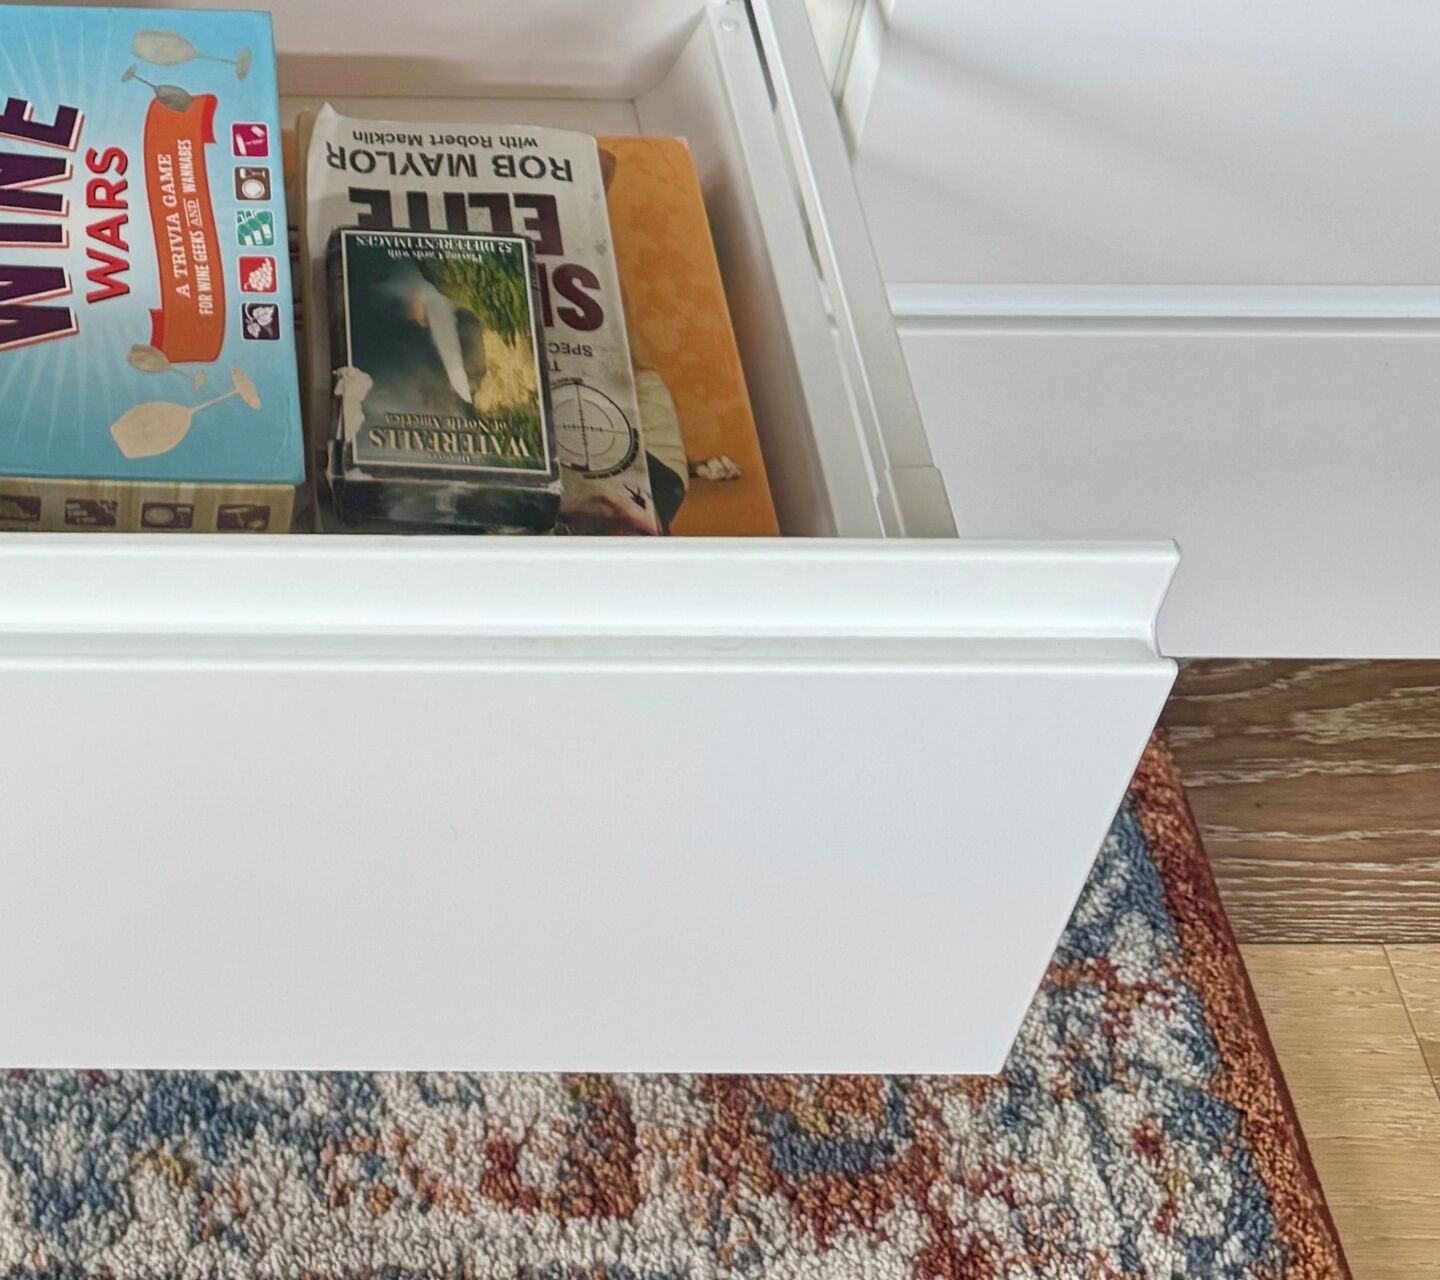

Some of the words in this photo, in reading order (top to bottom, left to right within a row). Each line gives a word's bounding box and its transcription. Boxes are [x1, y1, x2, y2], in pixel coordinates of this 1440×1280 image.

[352, 130, 423, 147] Macklin
[430, 132, 493, 148] Robert
[499, 137, 538, 149] with
[177, 139, 196, 192] WANNABES
[326, 142, 477, 179] MAYLOR
[492, 154, 573, 182] ROB
[157, 154, 177, 207] GAME
[187, 200, 201, 225] AND
[85, 146, 130, 303] WARS
[166, 212, 188, 278] TRIVIA
[189, 230, 208, 261] GEEKS
[355, 235, 412, 249] IMAGES
[416, 238, 495, 253] DIFFERENT
[498, 242, 513, 253] 52
[387, 249, 409, 258] with
[194, 264, 212, 291] WINE
[175, 283, 191, 298] A
[198, 294, 213, 314] FOR
[386, 414, 441, 429] America
[447, 417, 489, 433] North
[368, 428, 531, 458] WATERFALLS
